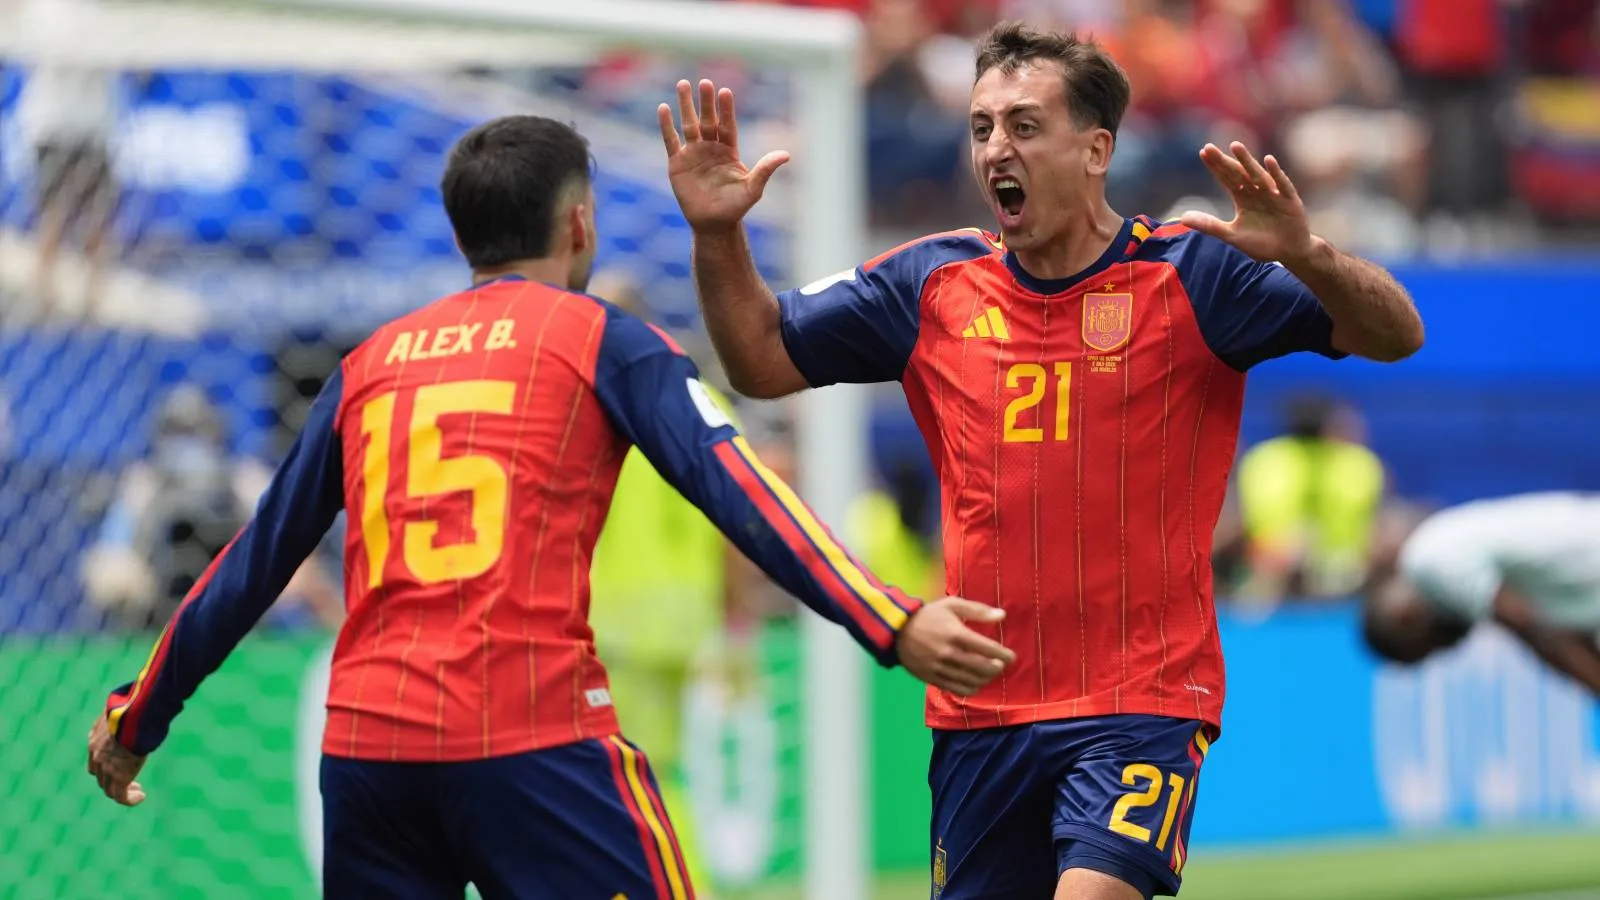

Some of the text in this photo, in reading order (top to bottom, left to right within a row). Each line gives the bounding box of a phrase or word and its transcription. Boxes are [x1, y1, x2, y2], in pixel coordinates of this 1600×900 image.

[384, 318, 517, 367] ALEX B.
[1003, 361, 1072, 443] 21
[361, 379, 517, 588] 15
[1108, 763, 1184, 852] 21
